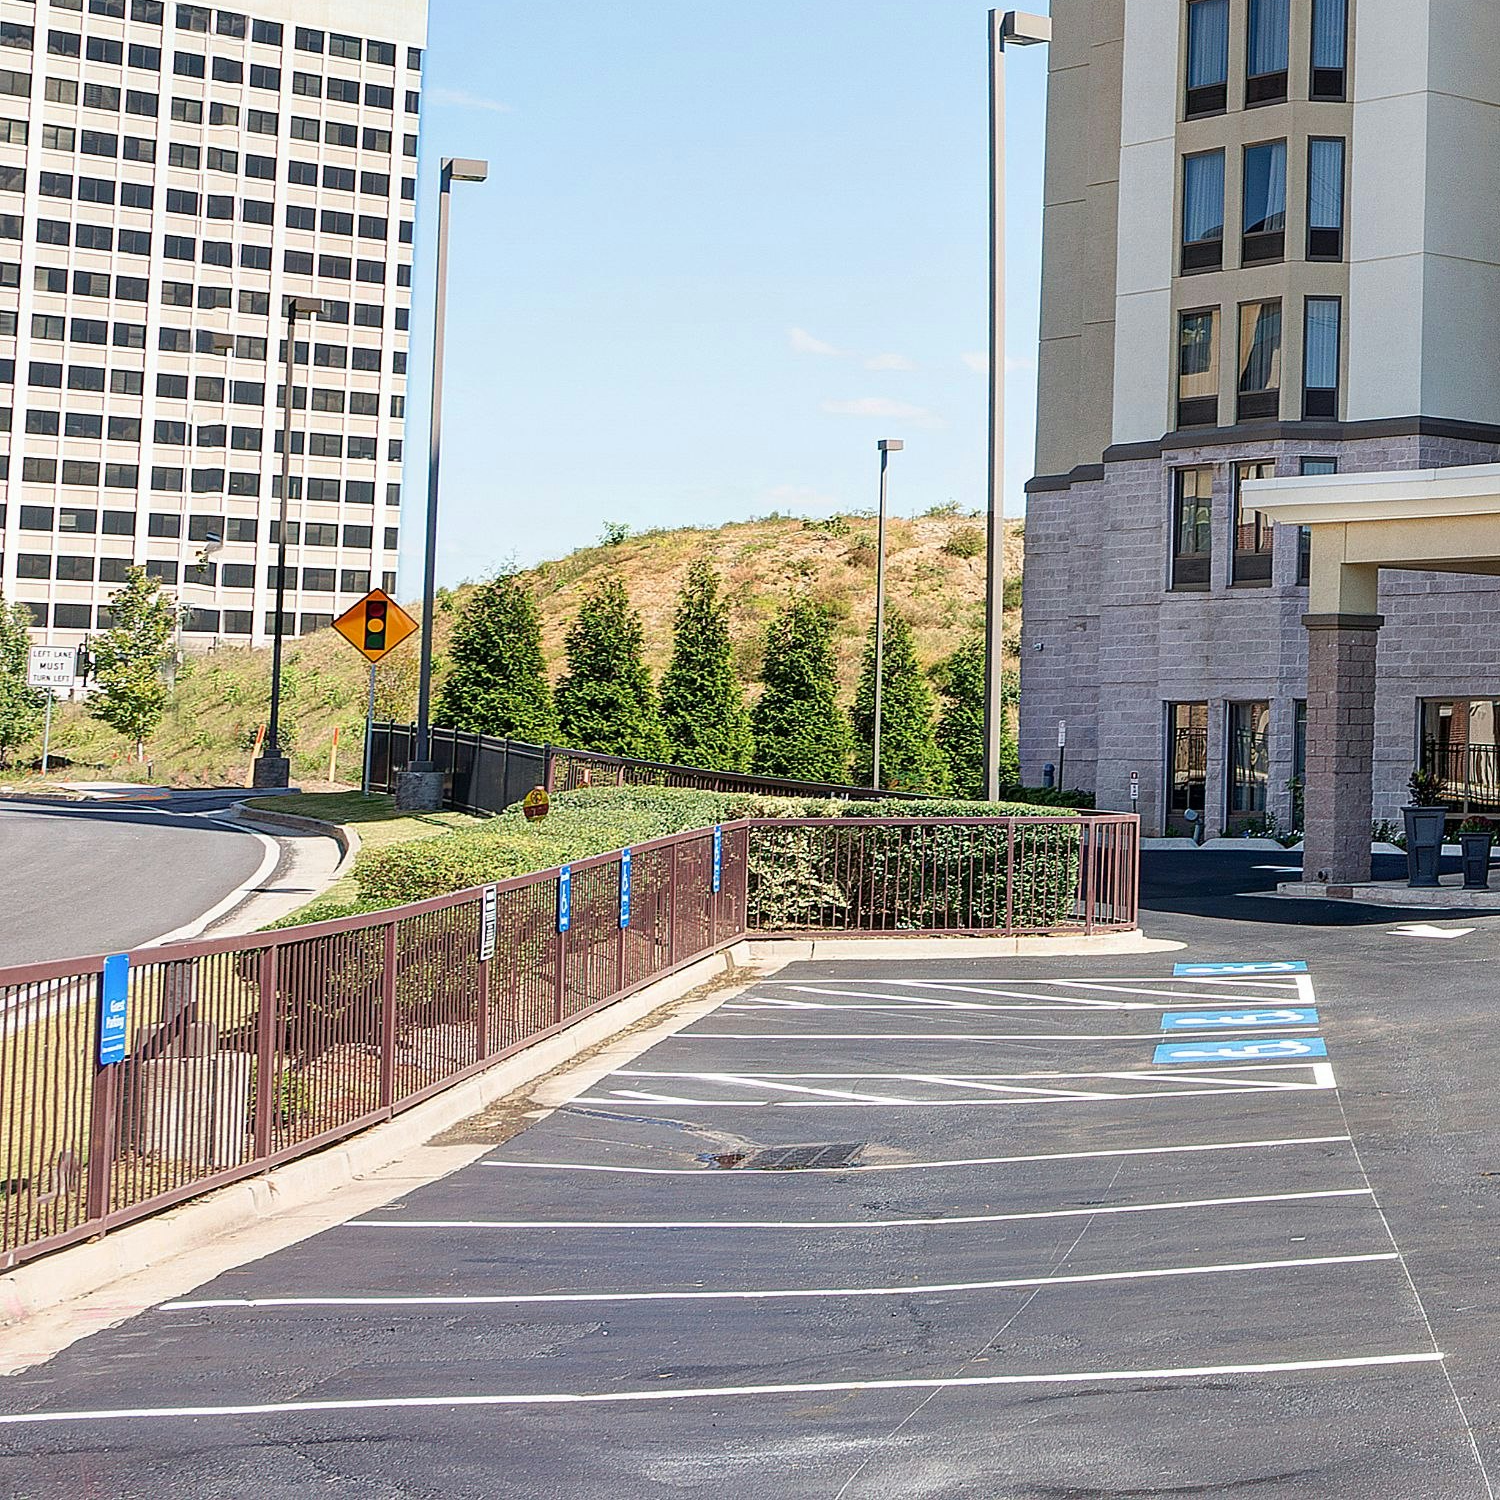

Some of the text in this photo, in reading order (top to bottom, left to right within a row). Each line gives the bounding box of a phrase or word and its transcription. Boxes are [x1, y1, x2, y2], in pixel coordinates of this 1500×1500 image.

[33, 650, 73, 659] LEFT LANE
[40, 662, 64, 671] MUST
[33, 674, 51, 682] TURN
